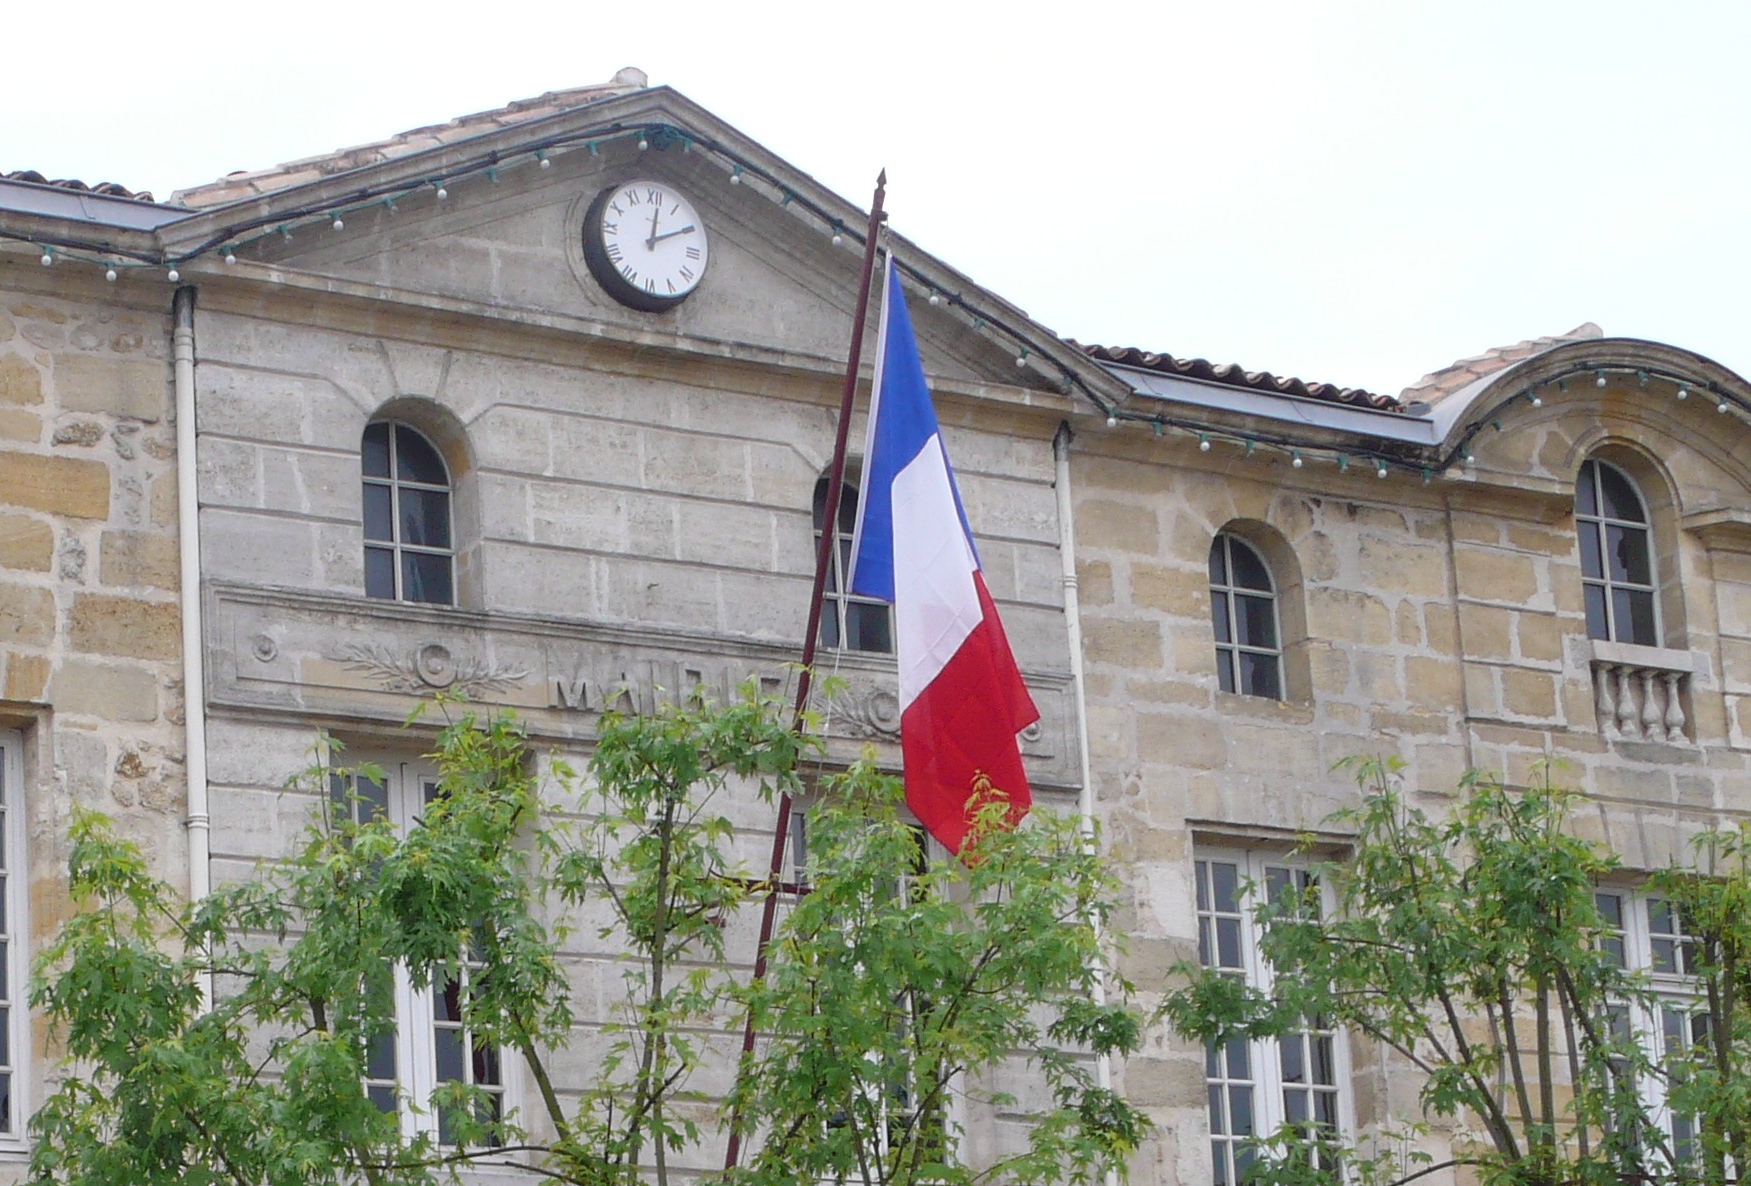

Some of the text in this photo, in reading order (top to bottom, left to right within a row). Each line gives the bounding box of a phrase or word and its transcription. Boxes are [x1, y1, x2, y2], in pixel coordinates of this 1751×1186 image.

[625, 189, 640, 207] XI
[647, 188, 663, 207] XII
[610, 201, 625, 217] X
[603, 221, 618, 235] IX
[686, 247, 700, 260] III
